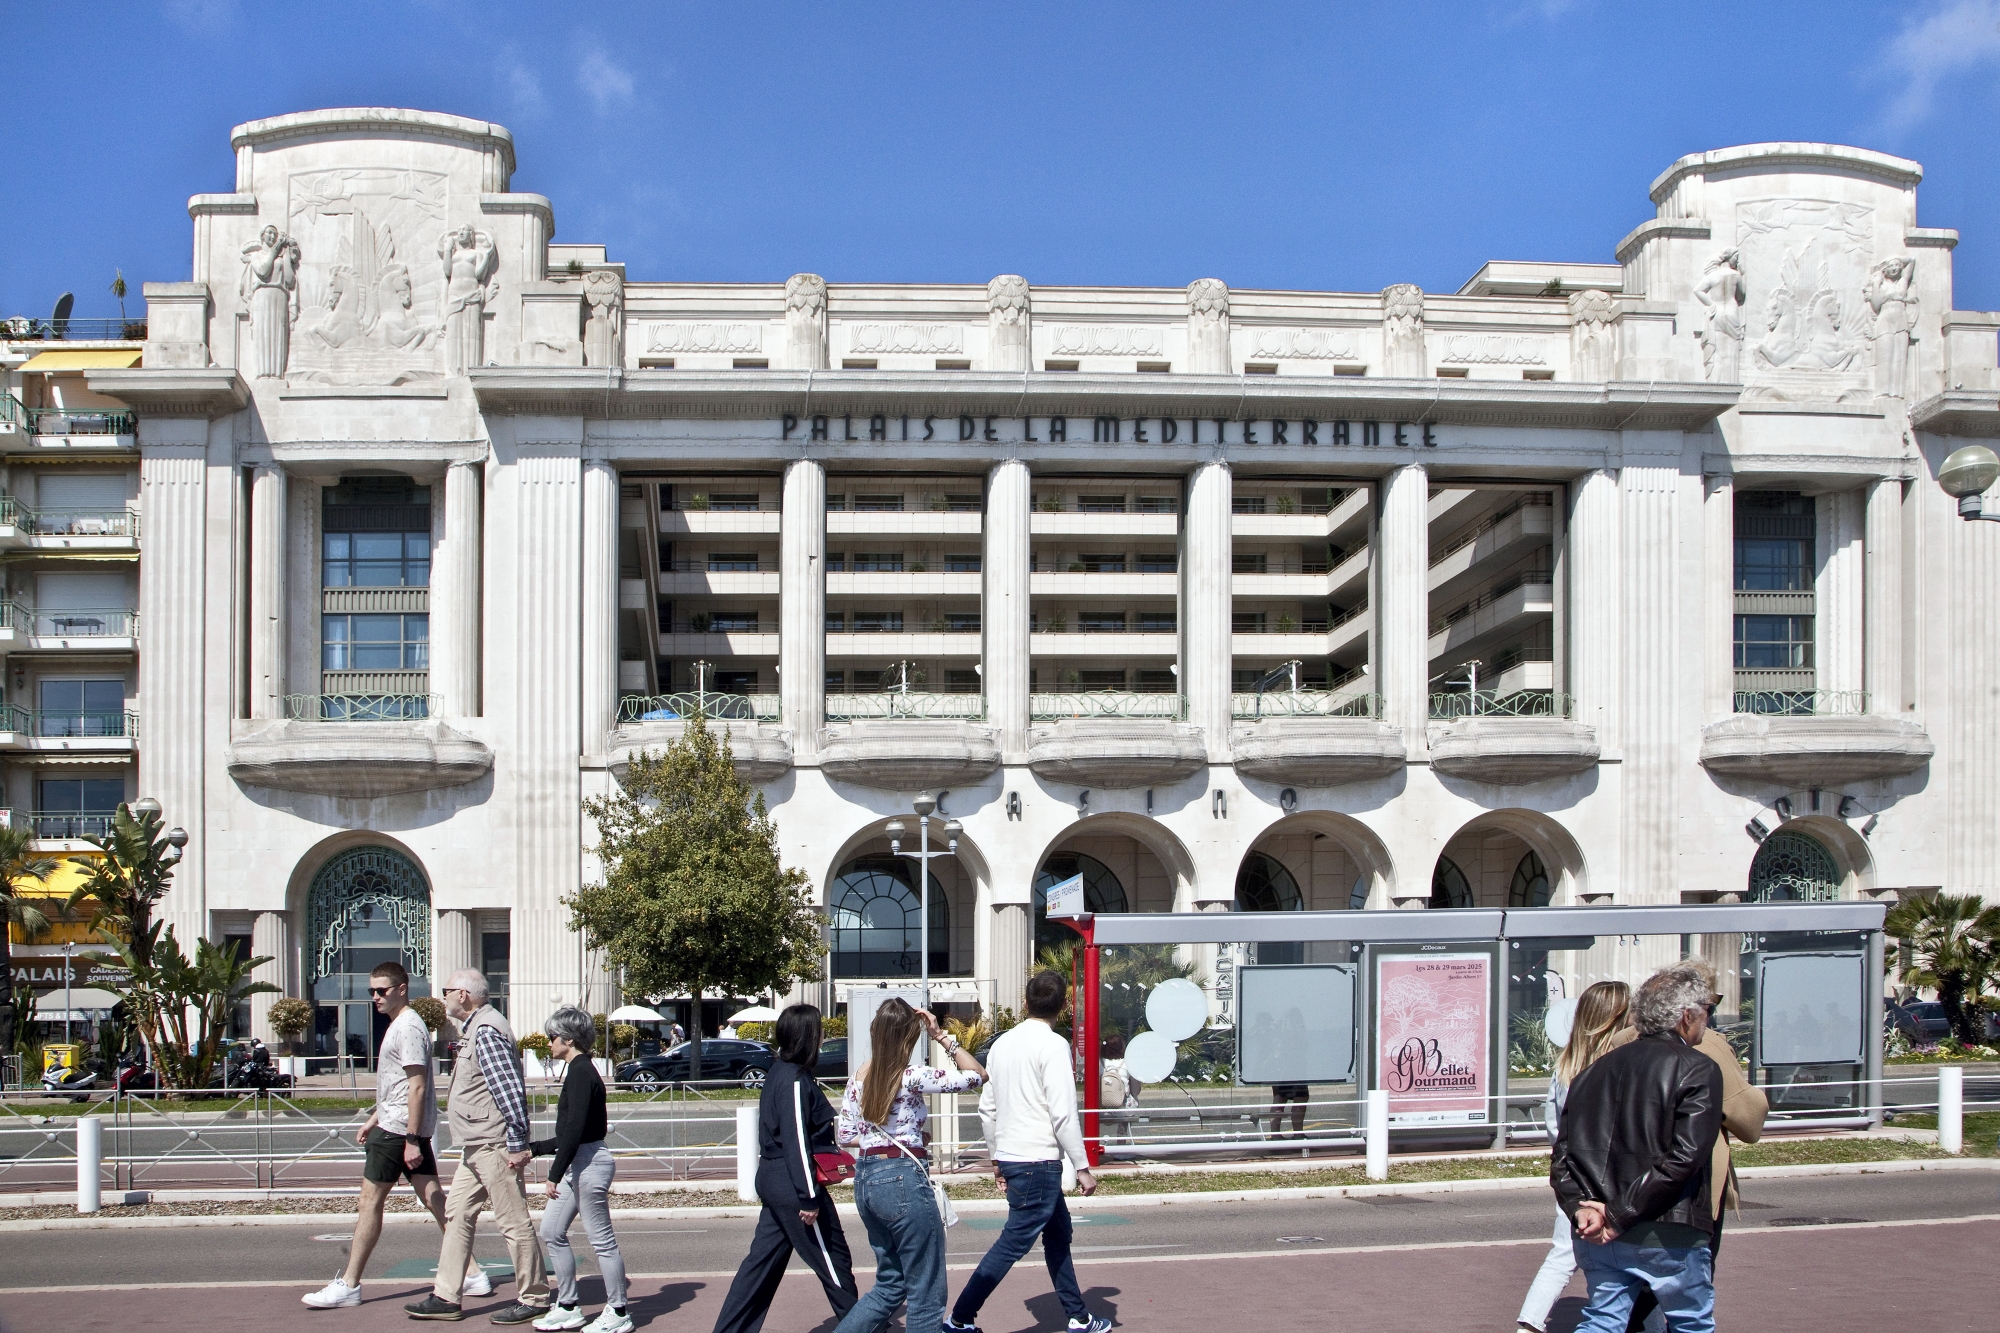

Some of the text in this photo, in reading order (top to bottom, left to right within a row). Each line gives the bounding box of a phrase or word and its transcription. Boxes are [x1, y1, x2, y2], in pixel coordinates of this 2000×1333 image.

[783, 414, 1437, 447] PALAIS DE LA MEDITERRANEE
[937, 788, 1297, 820] CASINO
[1745, 788, 1879, 844] HOTEL
[1388, 1045, 1476, 1092] Gourmand
[1404, 1037, 1469, 1077] Bellet
